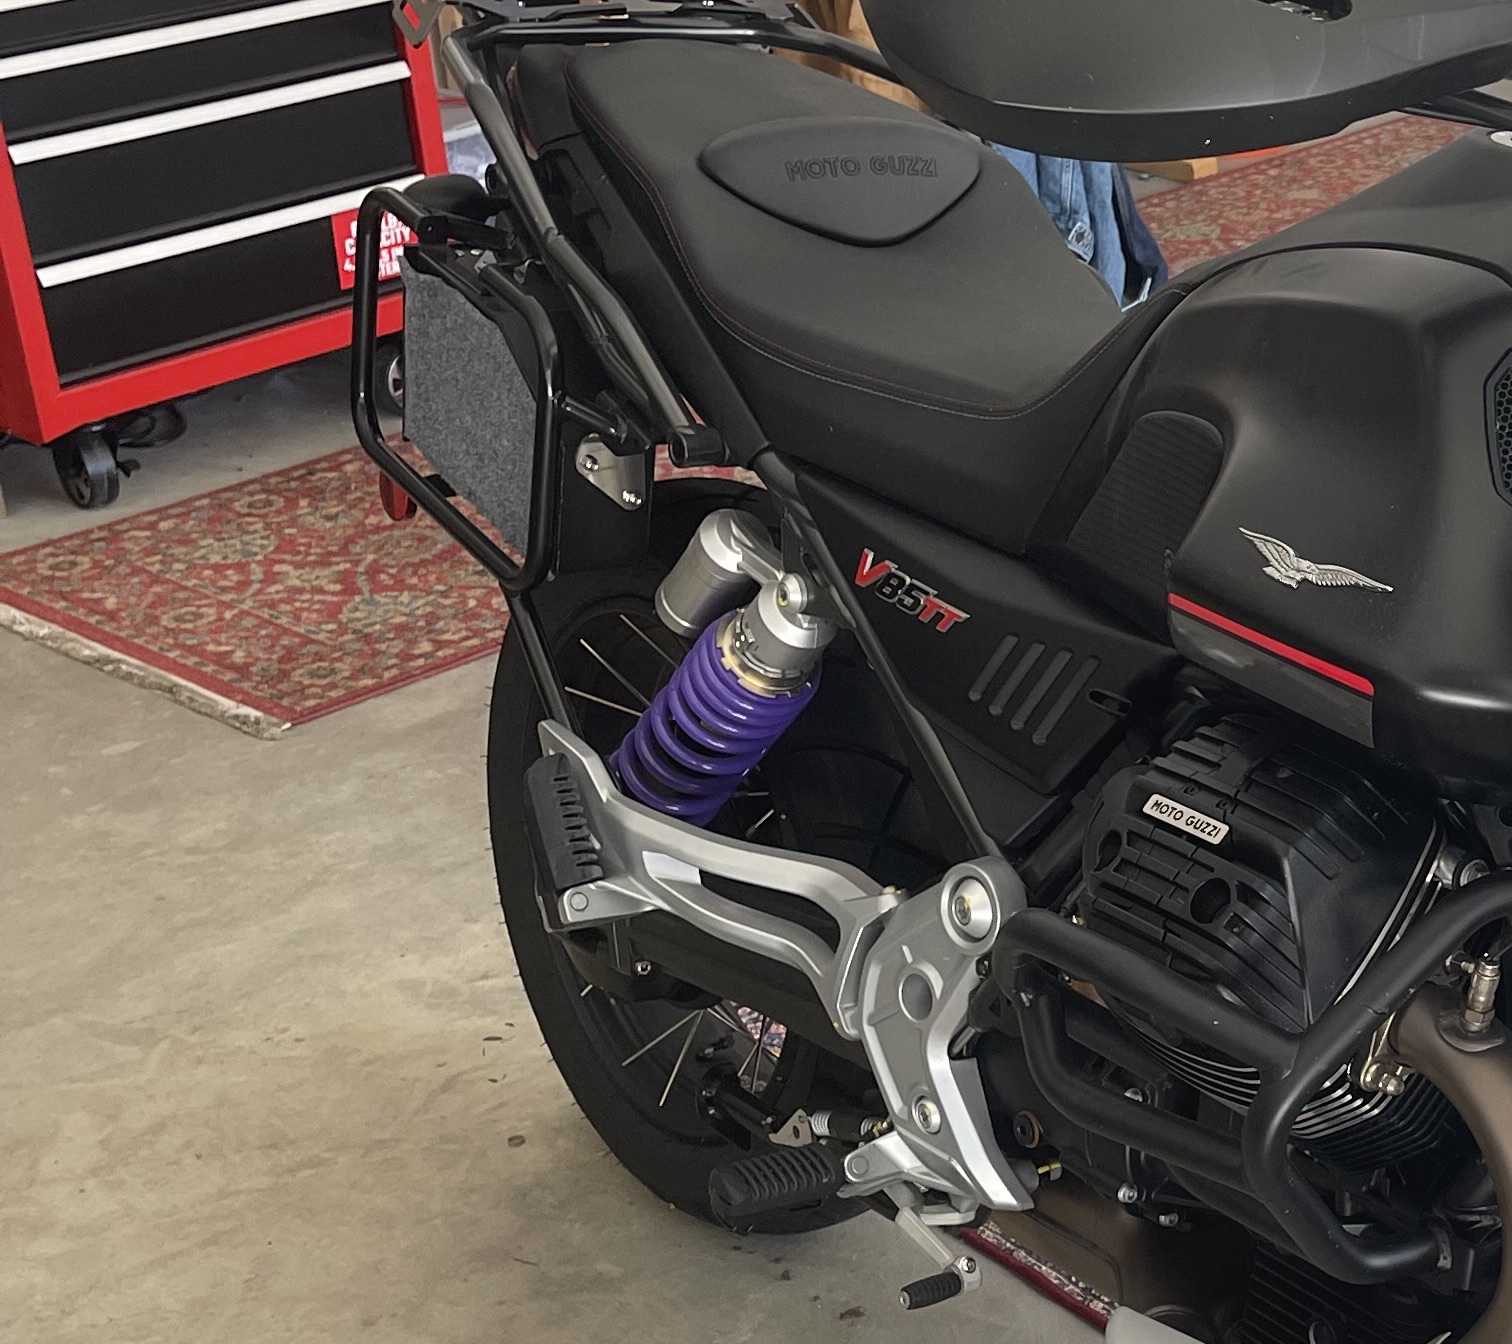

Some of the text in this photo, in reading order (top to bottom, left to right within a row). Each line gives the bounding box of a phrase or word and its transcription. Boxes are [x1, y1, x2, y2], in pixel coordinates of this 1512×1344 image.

[784, 155, 938, 182] MOTO GUZZI
[1150, 799, 1222, 838] MOTO GUZZI
